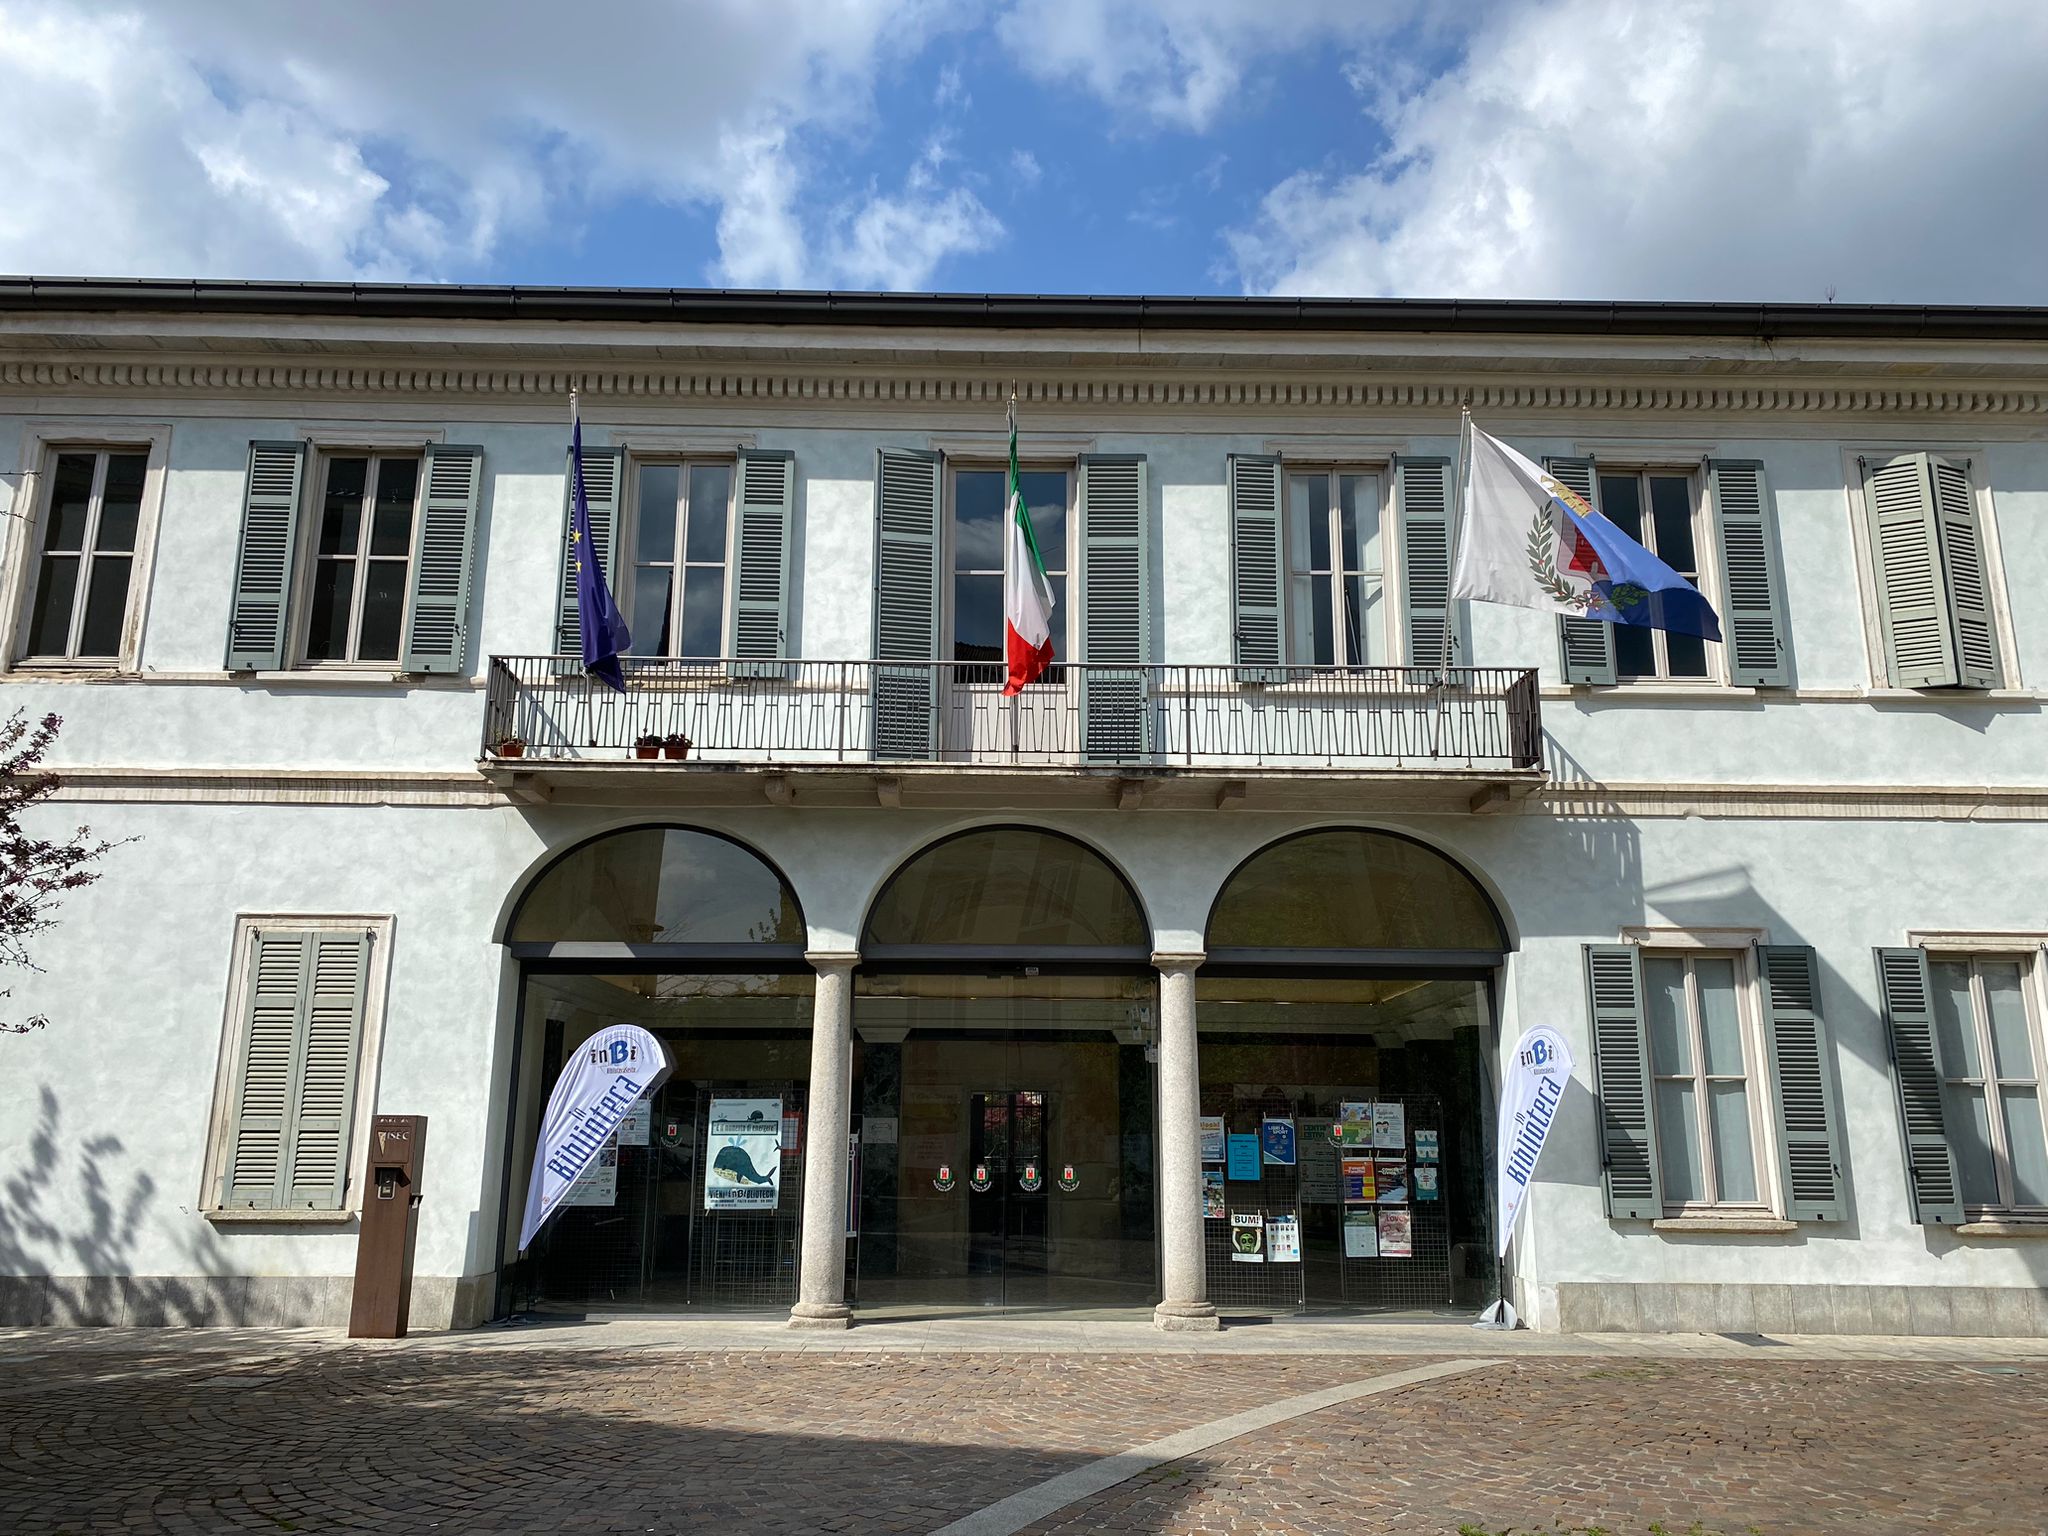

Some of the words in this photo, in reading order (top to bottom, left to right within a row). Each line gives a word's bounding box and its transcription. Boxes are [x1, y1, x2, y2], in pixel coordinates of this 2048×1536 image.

[591, 1041, 637, 1065] inBi
[1520, 1040, 1552, 1066] inBi
[568, 1107, 587, 1121] in
[1514, 1112, 1526, 1125] in
[547, 1075, 642, 1181] Biblioteca
[1506, 1076, 1561, 1186] Biblioteca
[1234, 1216, 1259, 1224] BUM!
